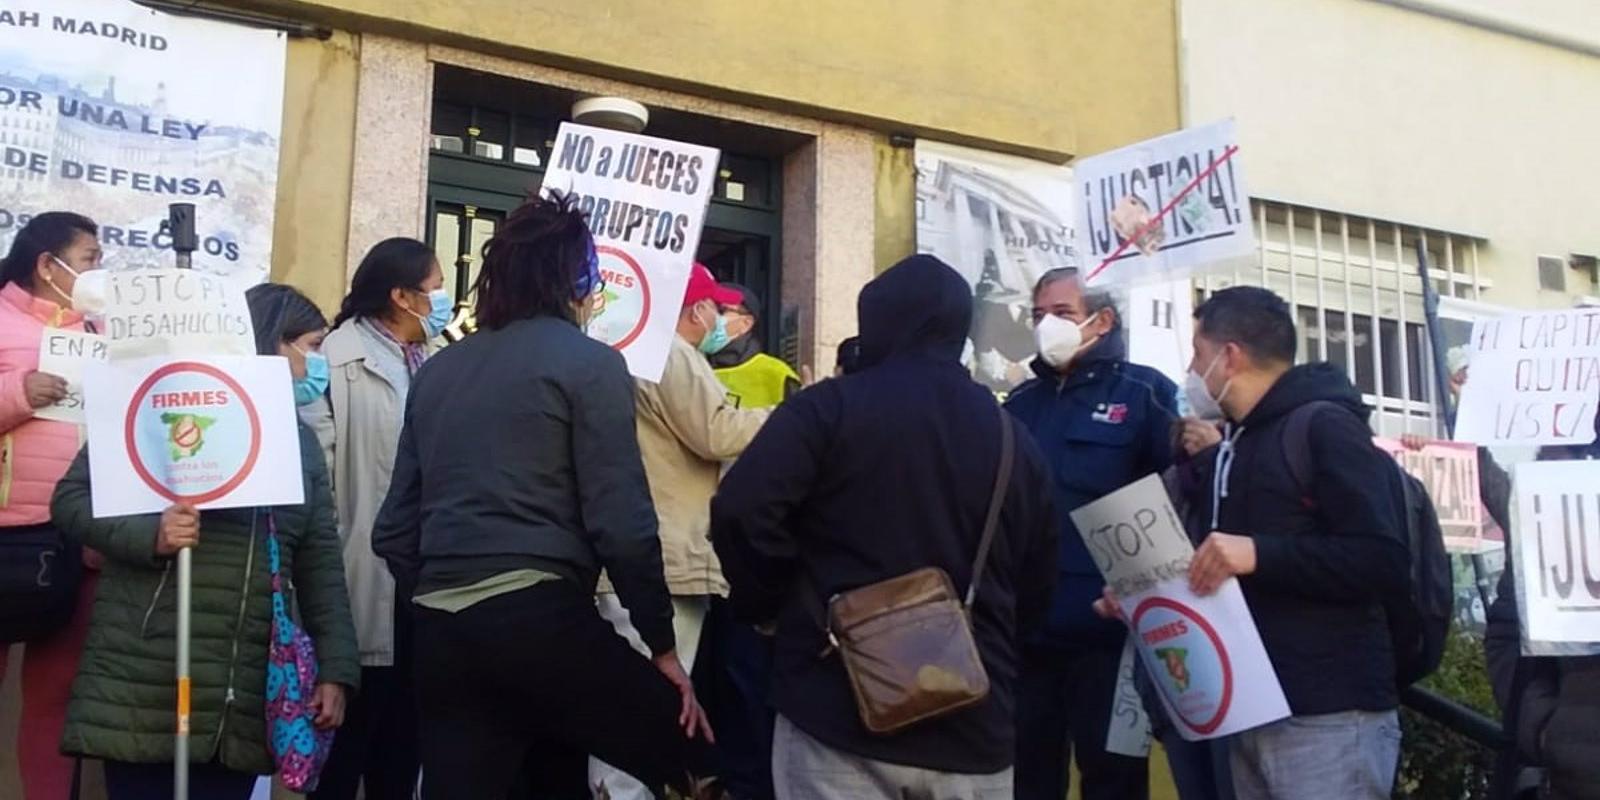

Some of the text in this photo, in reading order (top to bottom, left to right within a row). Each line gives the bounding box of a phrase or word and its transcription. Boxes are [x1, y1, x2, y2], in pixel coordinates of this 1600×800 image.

[53, 16, 167, 50] MADRID
[58, 96, 128, 130] UNA
[141, 115, 206, 140] LEY
[4, 148, 225, 198] DE DEFENSA
[558, 133, 702, 195] NO a JUECES
[110, 313, 248, 340] DESAHUCIOS
[49, 335, 84, 357] EN
[152, 390, 228, 409] FIRMES
